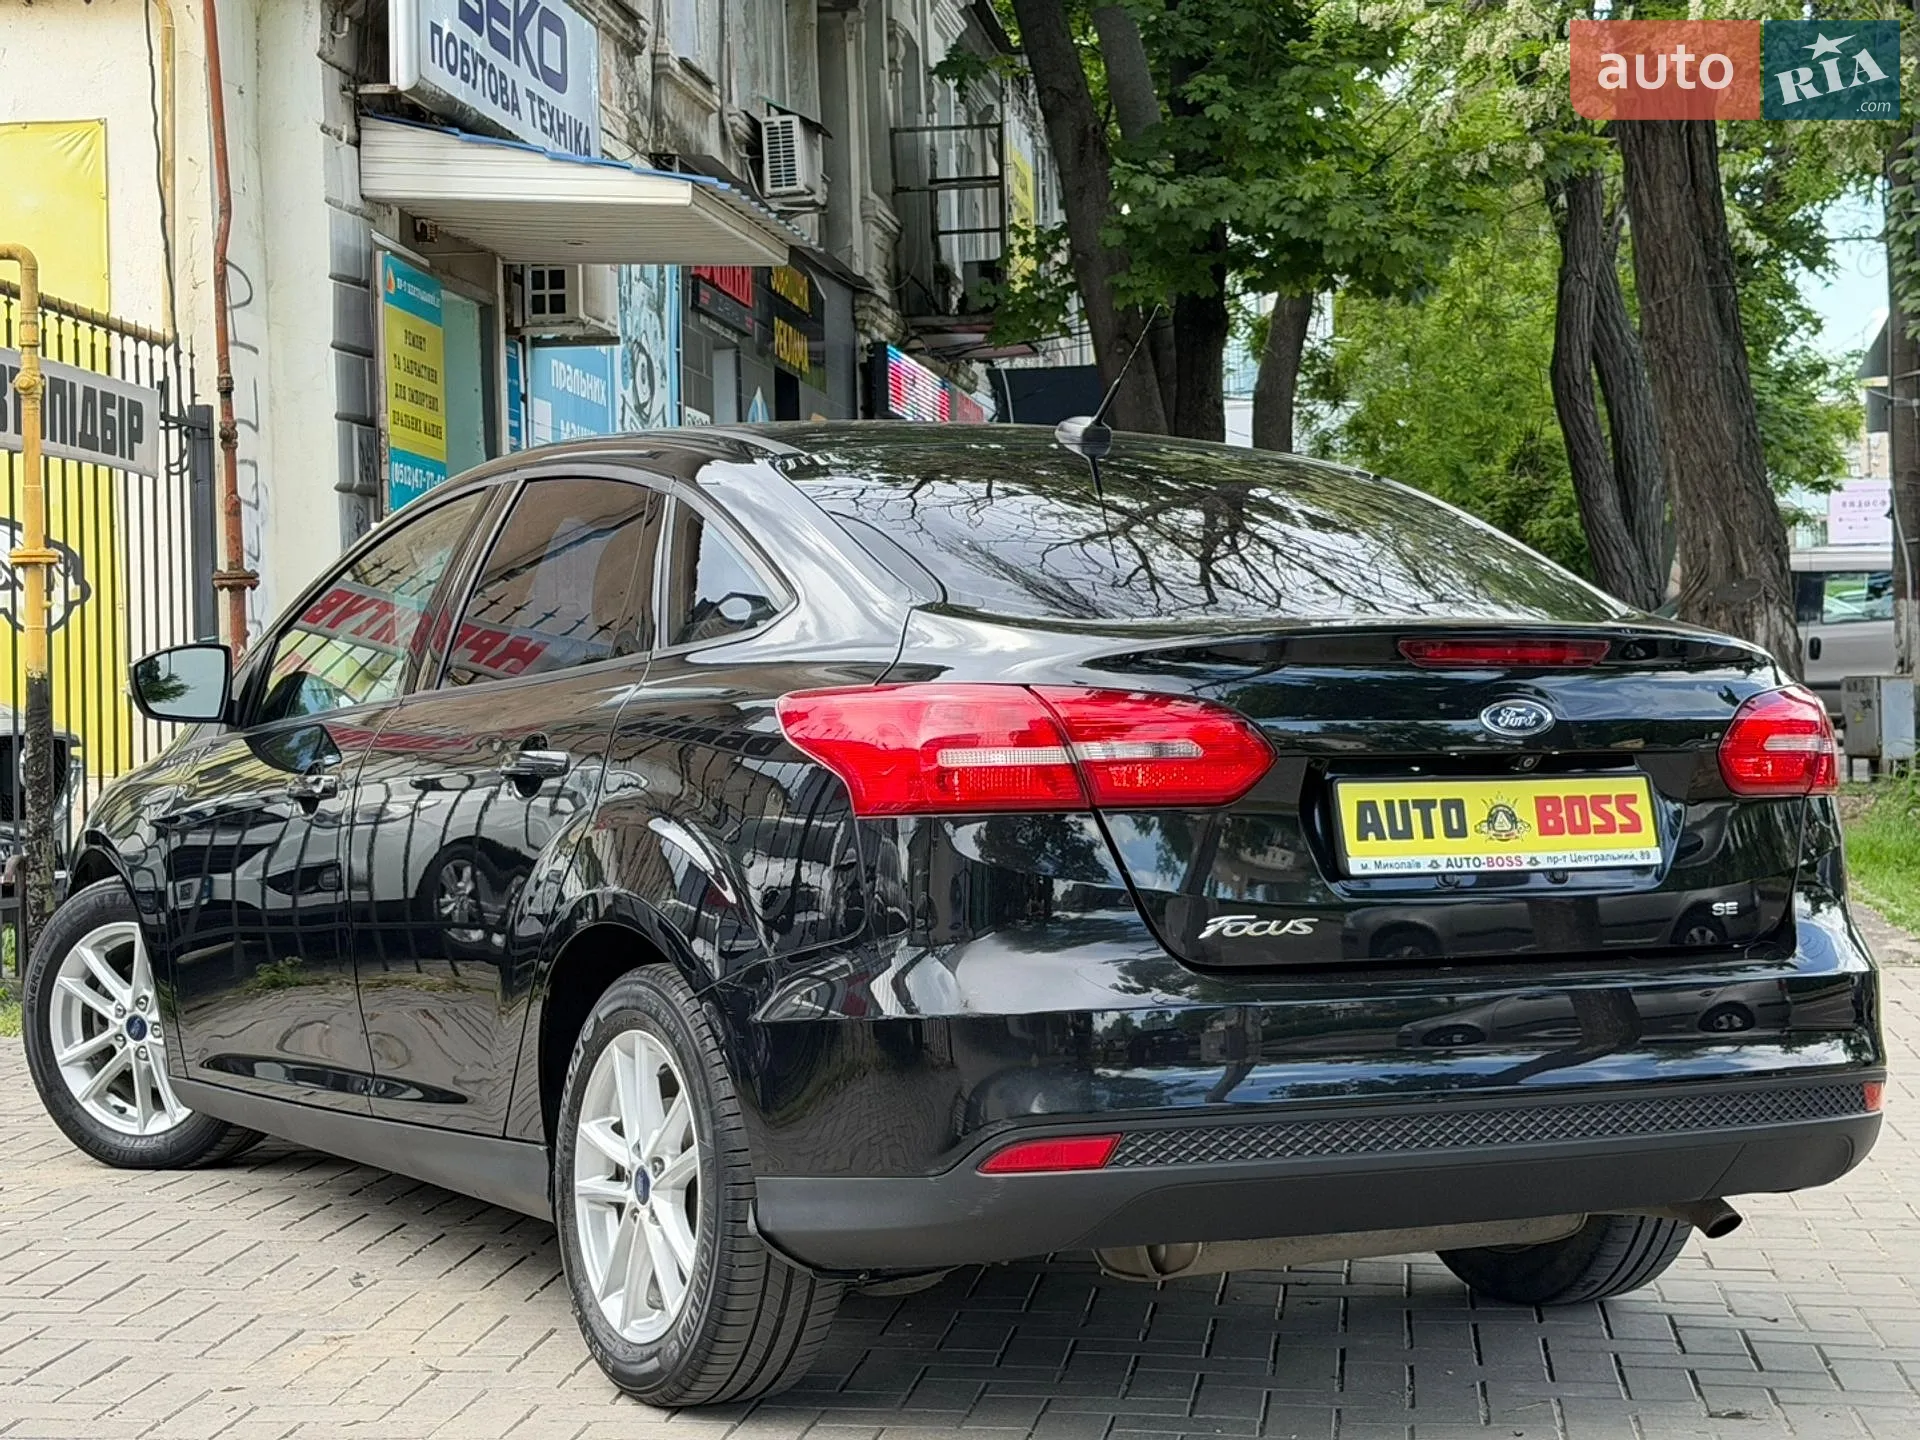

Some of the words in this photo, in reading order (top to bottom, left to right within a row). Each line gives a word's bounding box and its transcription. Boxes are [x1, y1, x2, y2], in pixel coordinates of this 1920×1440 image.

[430, 20, 522, 121] ПОБУТОВА
[525, 87, 591, 157] ТЕХНІКА
[393, 353, 401, 370] ТА
[394, 382, 406, 401] ДЛЯ
[551, 358, 607, 408] пральних
[1498, 706, 1536, 727] Ford
[1356, 798, 1468, 841] AUTO
[1534, 794, 1642, 836] BOSS
[1360, 861, 1373, 870] м.
[1374, 858, 1422, 870] Миколаїв
[1446, 855, 1524, 869] AUTO-BOSS
[1712, 901, 1739, 916] SE
